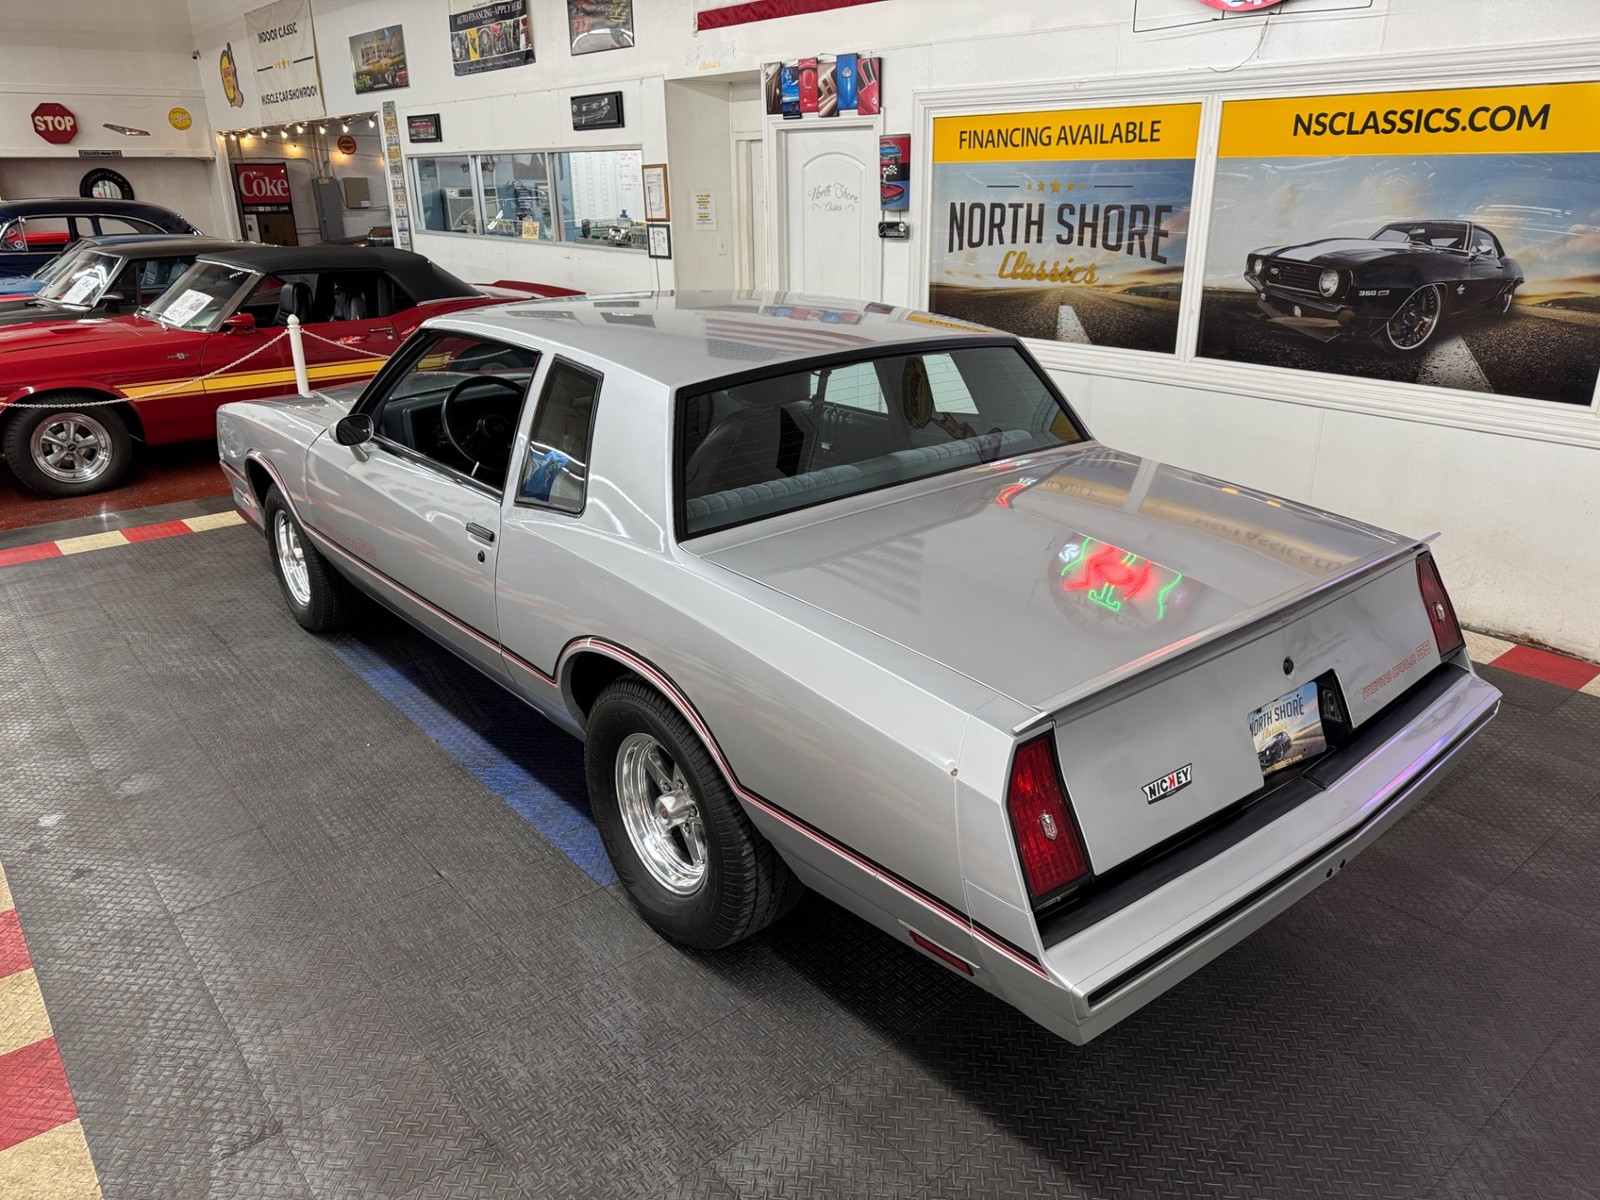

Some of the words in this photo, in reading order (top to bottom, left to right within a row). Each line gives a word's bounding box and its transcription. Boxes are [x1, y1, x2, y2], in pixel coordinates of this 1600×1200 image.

[34, 115, 75, 132] STOP
[1292, 103, 1551, 136] NSCLASSICS.COM
[958, 126, 1052, 150] FINANCING
[1056, 120, 1162, 146] AVAILABLE
[240, 171, 289, 197] Coke
[808, 184, 832, 201] North
[832, 182, 859, 204] Shore
[948, 202, 1046, 254] NORTH
[1055, 203, 1173, 265] SHORE
[998, 250, 1100, 285] Classics
[1415, 639, 1432, 661] SS
[1249, 708, 1273, 738] NORTH
[1274, 696, 1305, 723] SHORE
[1262, 722, 1288, 741] Classics
[1148, 767, 1189, 799] NICKEY
